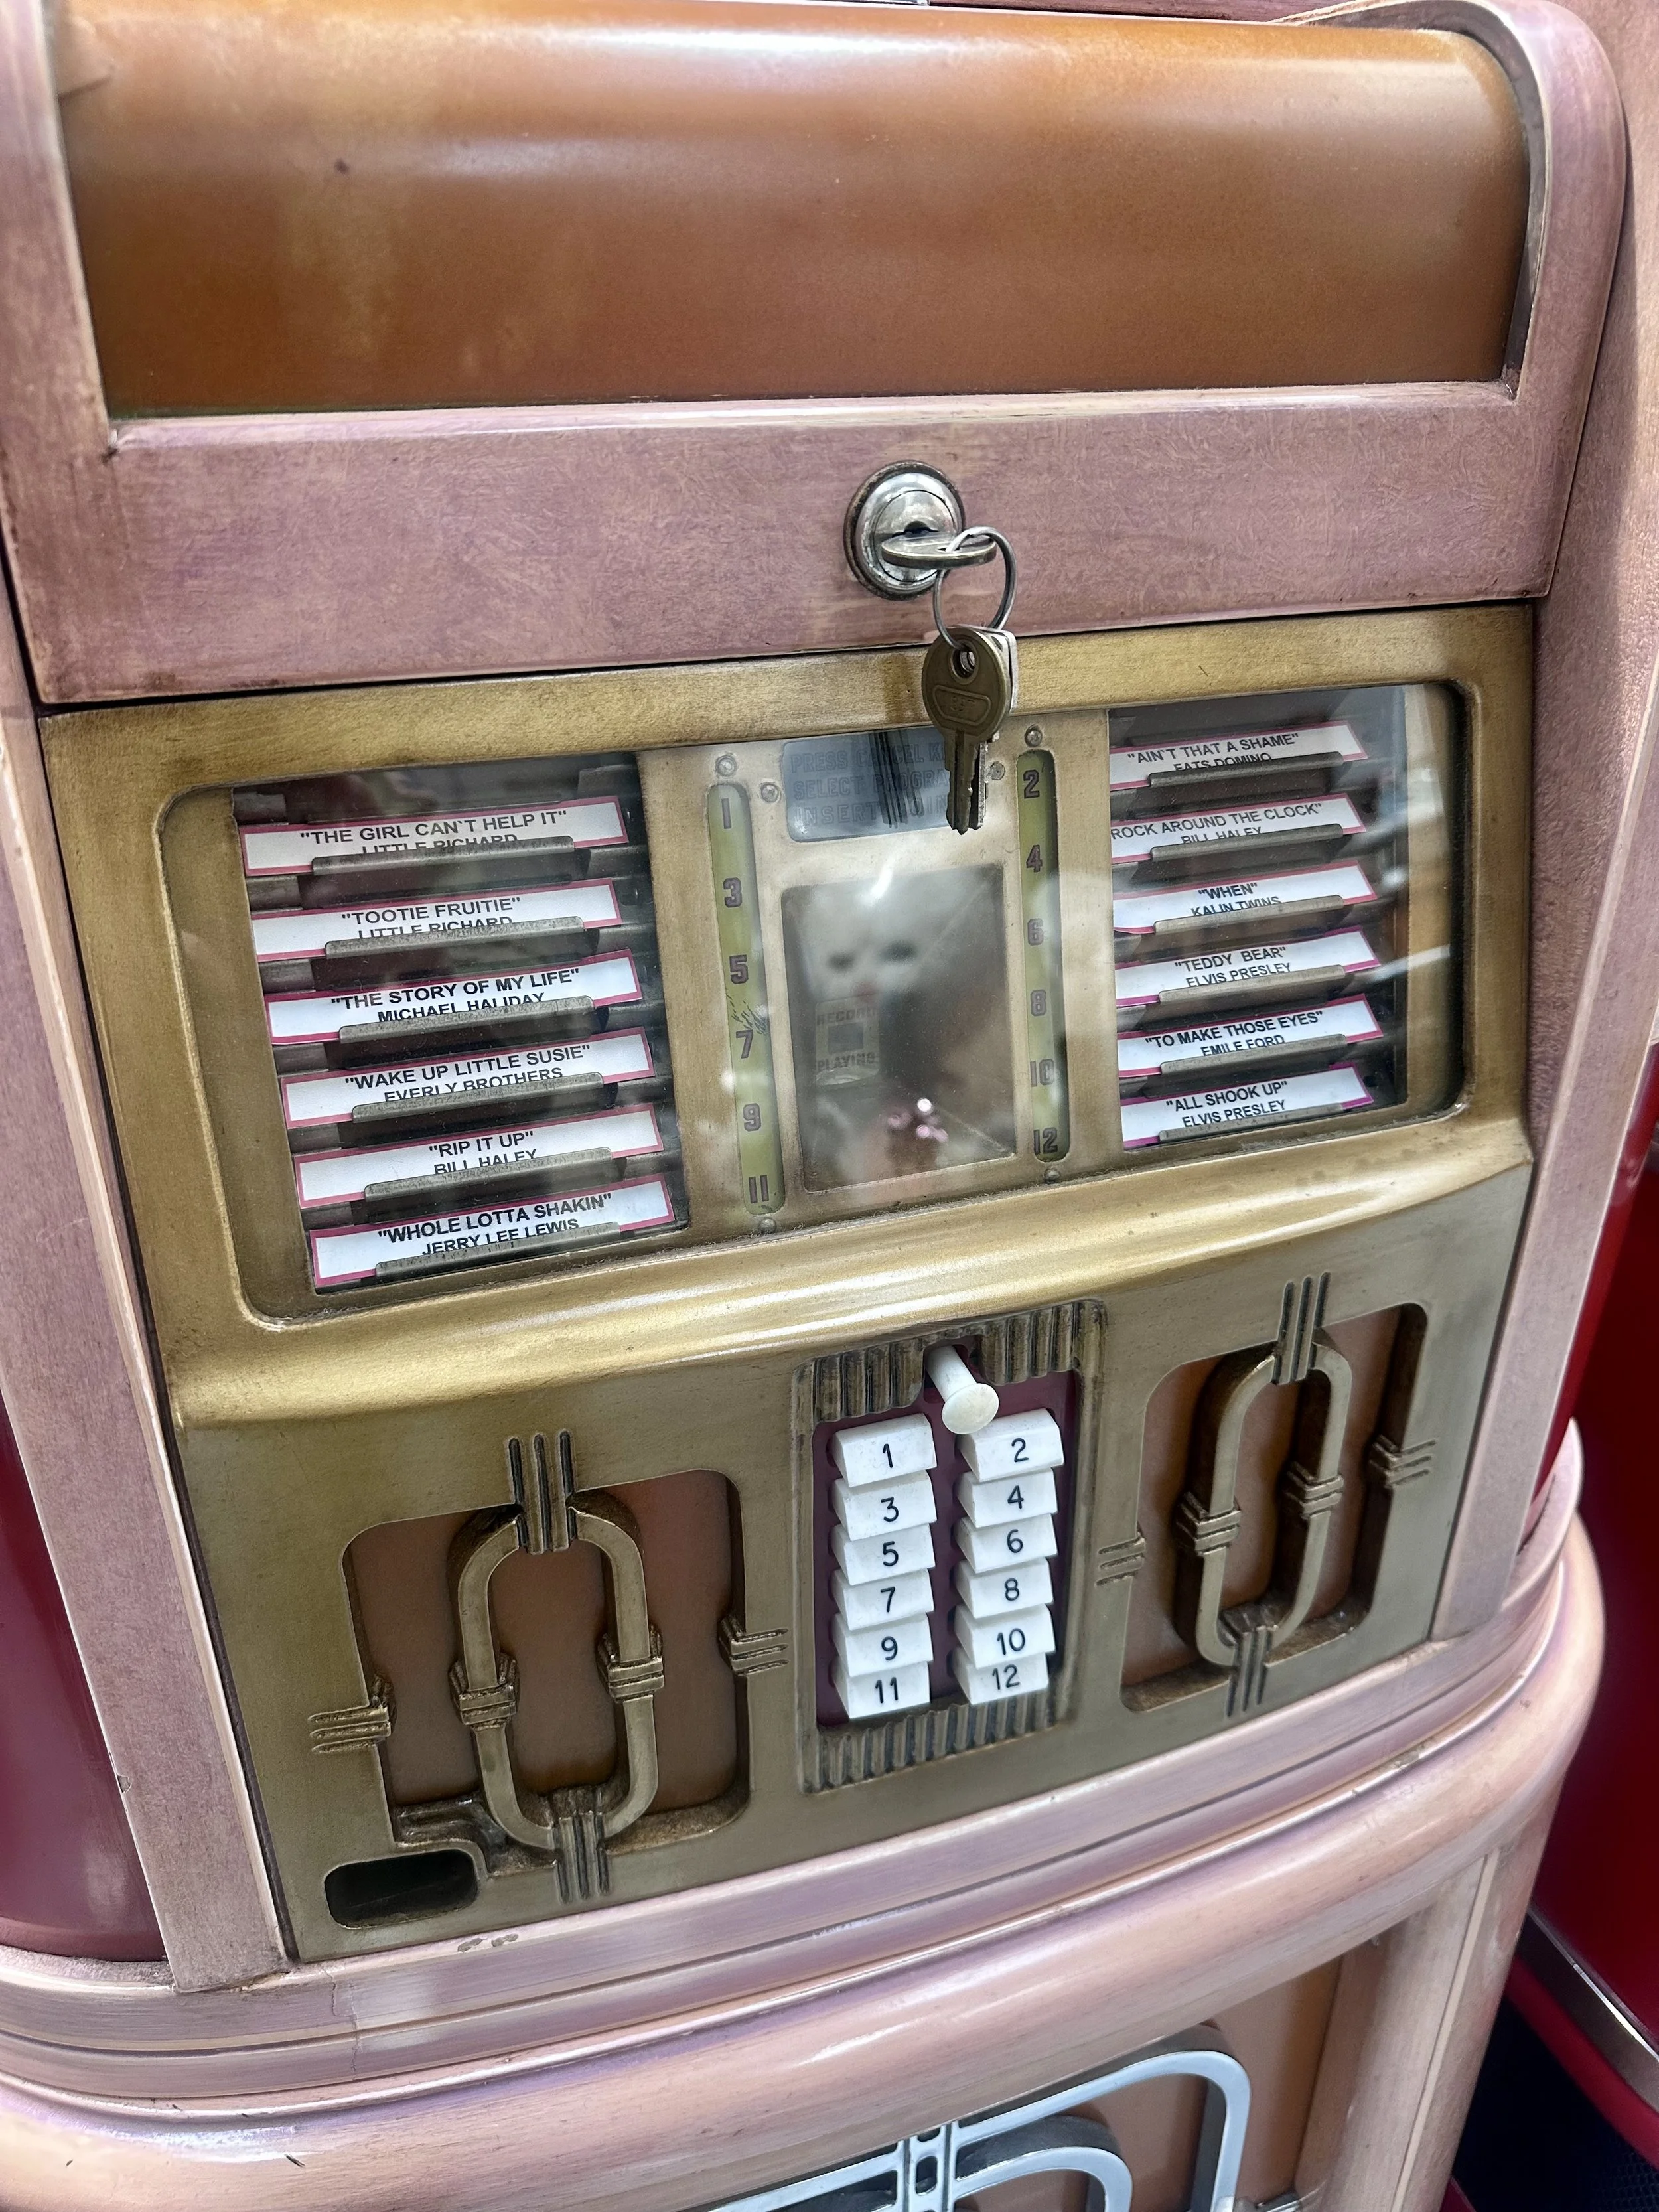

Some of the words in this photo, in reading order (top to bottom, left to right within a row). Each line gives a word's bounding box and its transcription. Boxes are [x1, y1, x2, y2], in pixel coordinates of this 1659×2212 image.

[790, 749, 848, 773] PRESS
[856, 744, 924, 767] CACEL
[1179, 743, 1220, 758] THAT
[1227, 741, 1237, 753] A
[1241, 733, 1299, 750] SHAME"
[793, 776, 864, 800] SELECT
[1023, 770, 1040, 798] 2
[721, 798, 731, 829] 1
[795, 801, 879, 826] INSERT
[1162, 815, 1226, 834] AROUND
[1228, 810, 1262, 824] THE
[1263, 803, 1323, 820] CLOCK"
[300, 830, 352, 846] "THE
[360, 825, 409, 841] GIRL
[482, 814, 535, 830] HELP
[541, 810, 567, 825] IT"
[1026, 845, 1043, 873] 4
[723, 877, 743, 908] 3
[1198, 882, 1258, 899] "WHEN"
[342, 906, 429, 924] "TOOTIE
[435, 897, 520, 918] FRUITIE"
[1027, 919, 1044, 946] 6
[729, 954, 749, 984] 5
[1175, 953, 1232, 972] "TEDDY
[1240, 946, 1286, 962] BEAR"
[331, 993, 383, 1009] "THE
[388, 984, 457, 1003] STORY
[463, 981, 490, 995] OF
[497, 976, 525, 992] MY
[530, 968, 579, 987] LIFE"
[1186, 972, 1227, 988] ELVIS
[1229, 962, 1291, 981] PRESLEY
[1031, 989, 1046, 1016] 8
[1145, 1035, 1175, 1048] "TO
[1178, 1027, 1223, 1045] MAKE
[1223, 1019, 1276, 1037] THOSE
[1278, 1011, 1323, 1028] EYES"
[736, 1030, 753, 1058] 7
[1200, 1041, 1247, 1057] EMILE
[1248, 1035, 1285, 1049] FORD
[345, 1069, 417, 1089] "WAKE
[422, 1065, 449, 1081] UP
[455, 1055, 522, 1076] LITTLE
[527, 1045, 591, 1065] SUSIE"
[464, 1067, 563, 1090] BROTHERS
[1030, 1058, 1054, 1087] 10
[1166, 1098, 1202, 1112] "ALL
[1206, 1086, 1262, 1106] SHOOK
[1262, 1080, 1287, 1096] UP"
[743, 1103, 762, 1131] 9
[1182, 1111, 1221, 1128] ELVIS
[1225, 1100, 1285, 1120] PRESLEY
[429, 1141, 470, 1157] "RIP
[476, 1137, 493, 1151] IT
[499, 1131, 534, 1148] UP"
[1033, 1127, 1058, 1155] 12
[749, 1175, 770, 1204] 11
[378, 1217, 461, 1243] "WHOLE
[466, 1207, 530, 1228] LOTTA
[534, 1193, 611, 1218] SHAKIN"
[422, 1235, 480, 1256] JERRY
[486, 1229, 520, 1244] LEE
[525, 1218, 579, 1238] LEWIS
[883, 1443, 893, 1468] 1
[1011, 1438, 1029, 1462] 2
[881, 1497, 899, 1522] 3
[1007, 1485, 1024, 1509] 4
[883, 1541, 899, 1566] 5
[1007, 1529, 1023, 1553] 6
[881, 1587, 896, 1612] 7
[1005, 1578, 1020, 1601] 8
[881, 1636, 897, 1660] 9
[997, 1628, 1025, 1655] 10
[875, 1676, 899, 1704] 11
[992, 1664, 1020, 1690] 12
